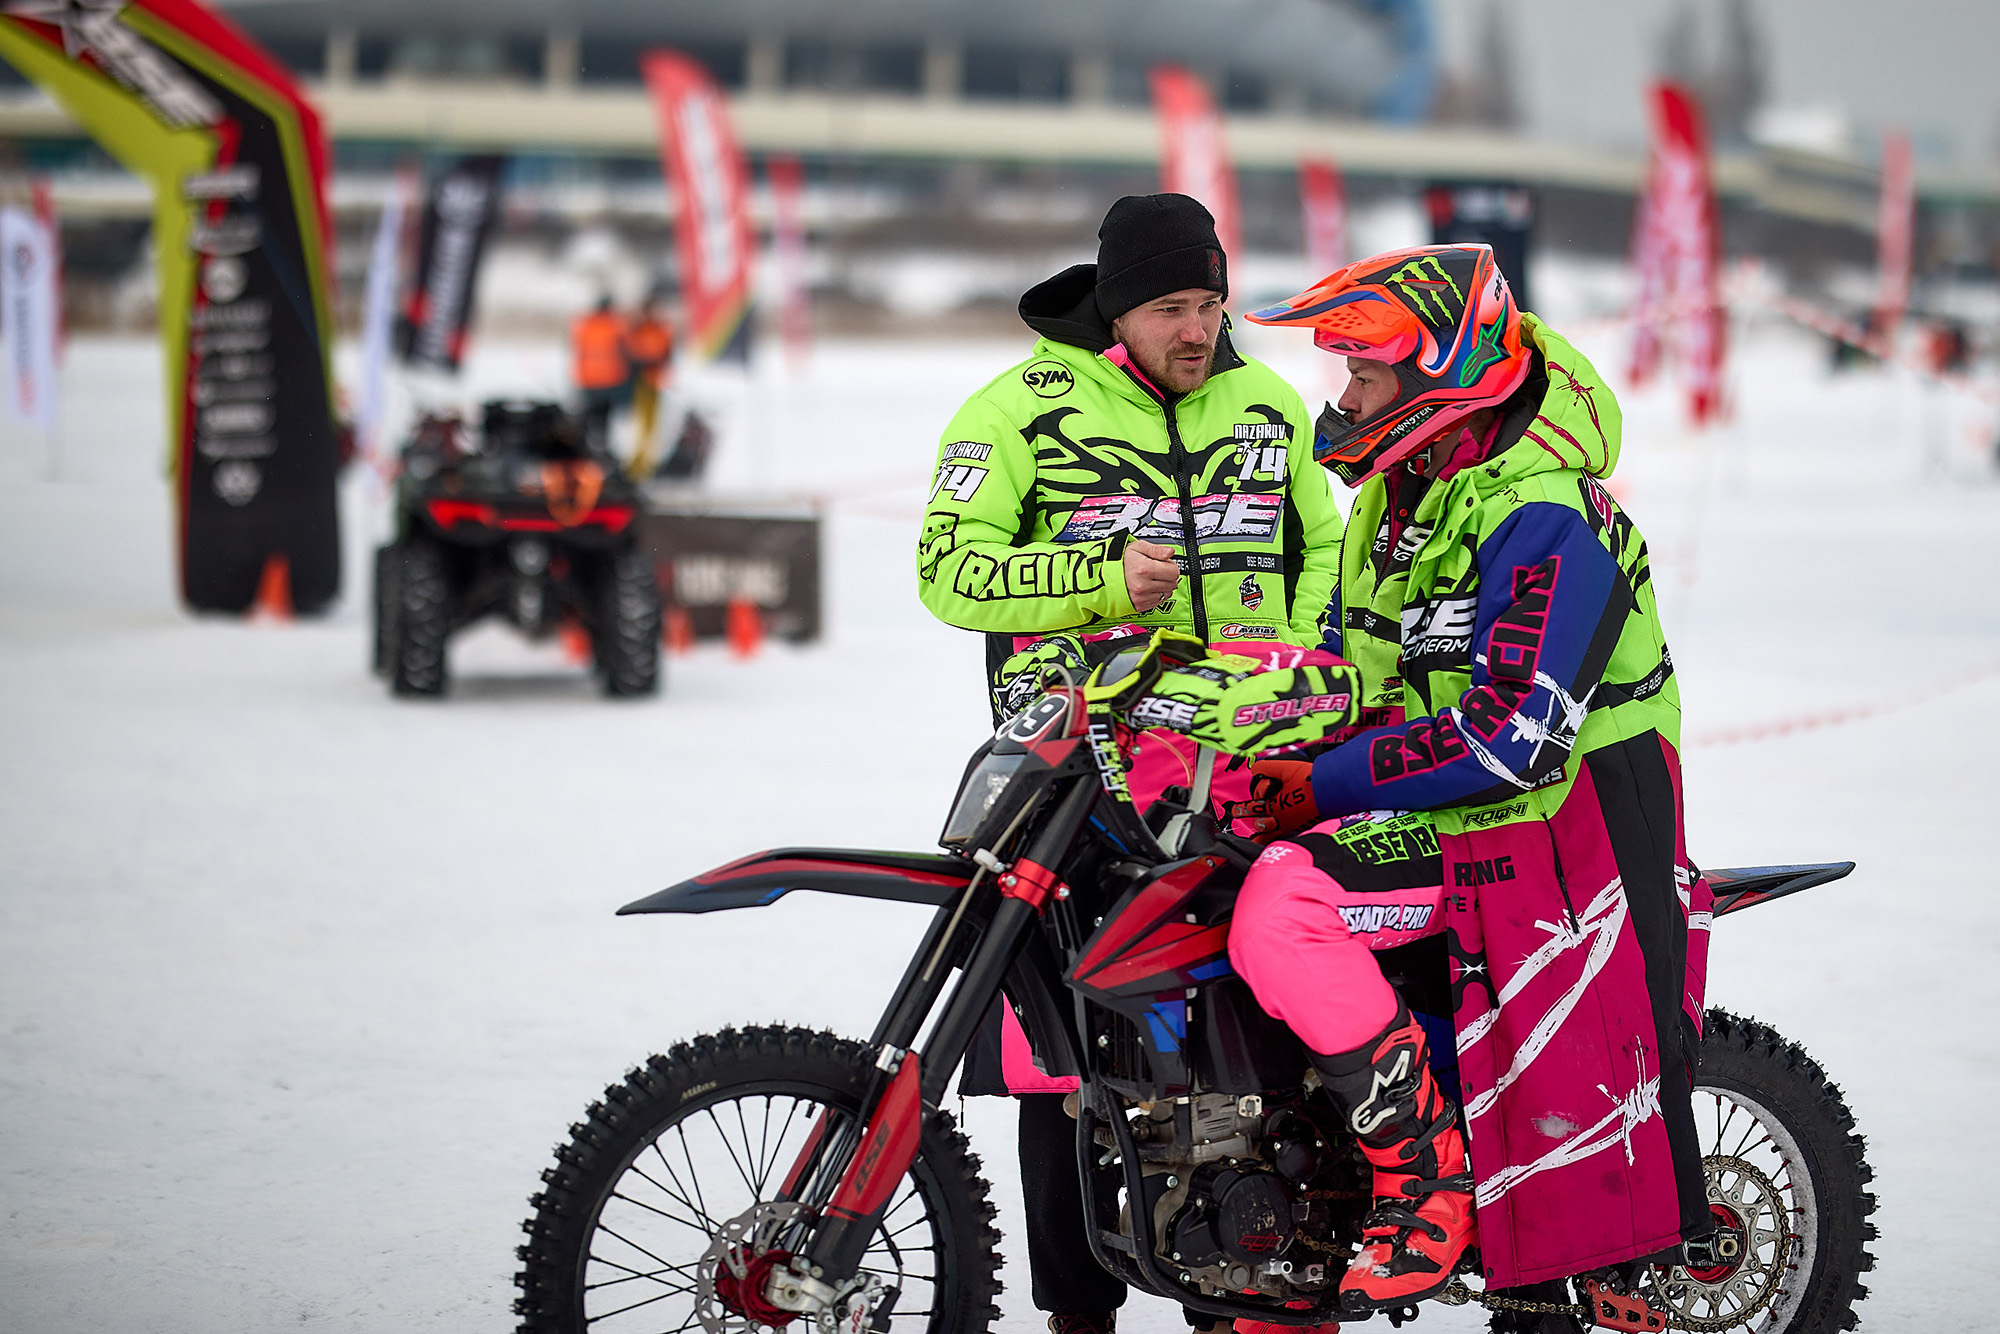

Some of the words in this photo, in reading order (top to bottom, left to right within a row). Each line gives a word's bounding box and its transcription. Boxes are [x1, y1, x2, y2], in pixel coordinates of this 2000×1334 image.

[1026, 370, 1072, 389] SYM
[1234, 424, 1286, 439] NAZAROV
[1389, 405, 1433, 437] MONSTER
[1052, 493, 1284, 543] BSE
[953, 541, 1106, 601] RACING
[1132, 696, 1199, 724] BSE
[1233, 691, 1350, 727] STOLPER
[1369, 713, 1470, 786] BSE
